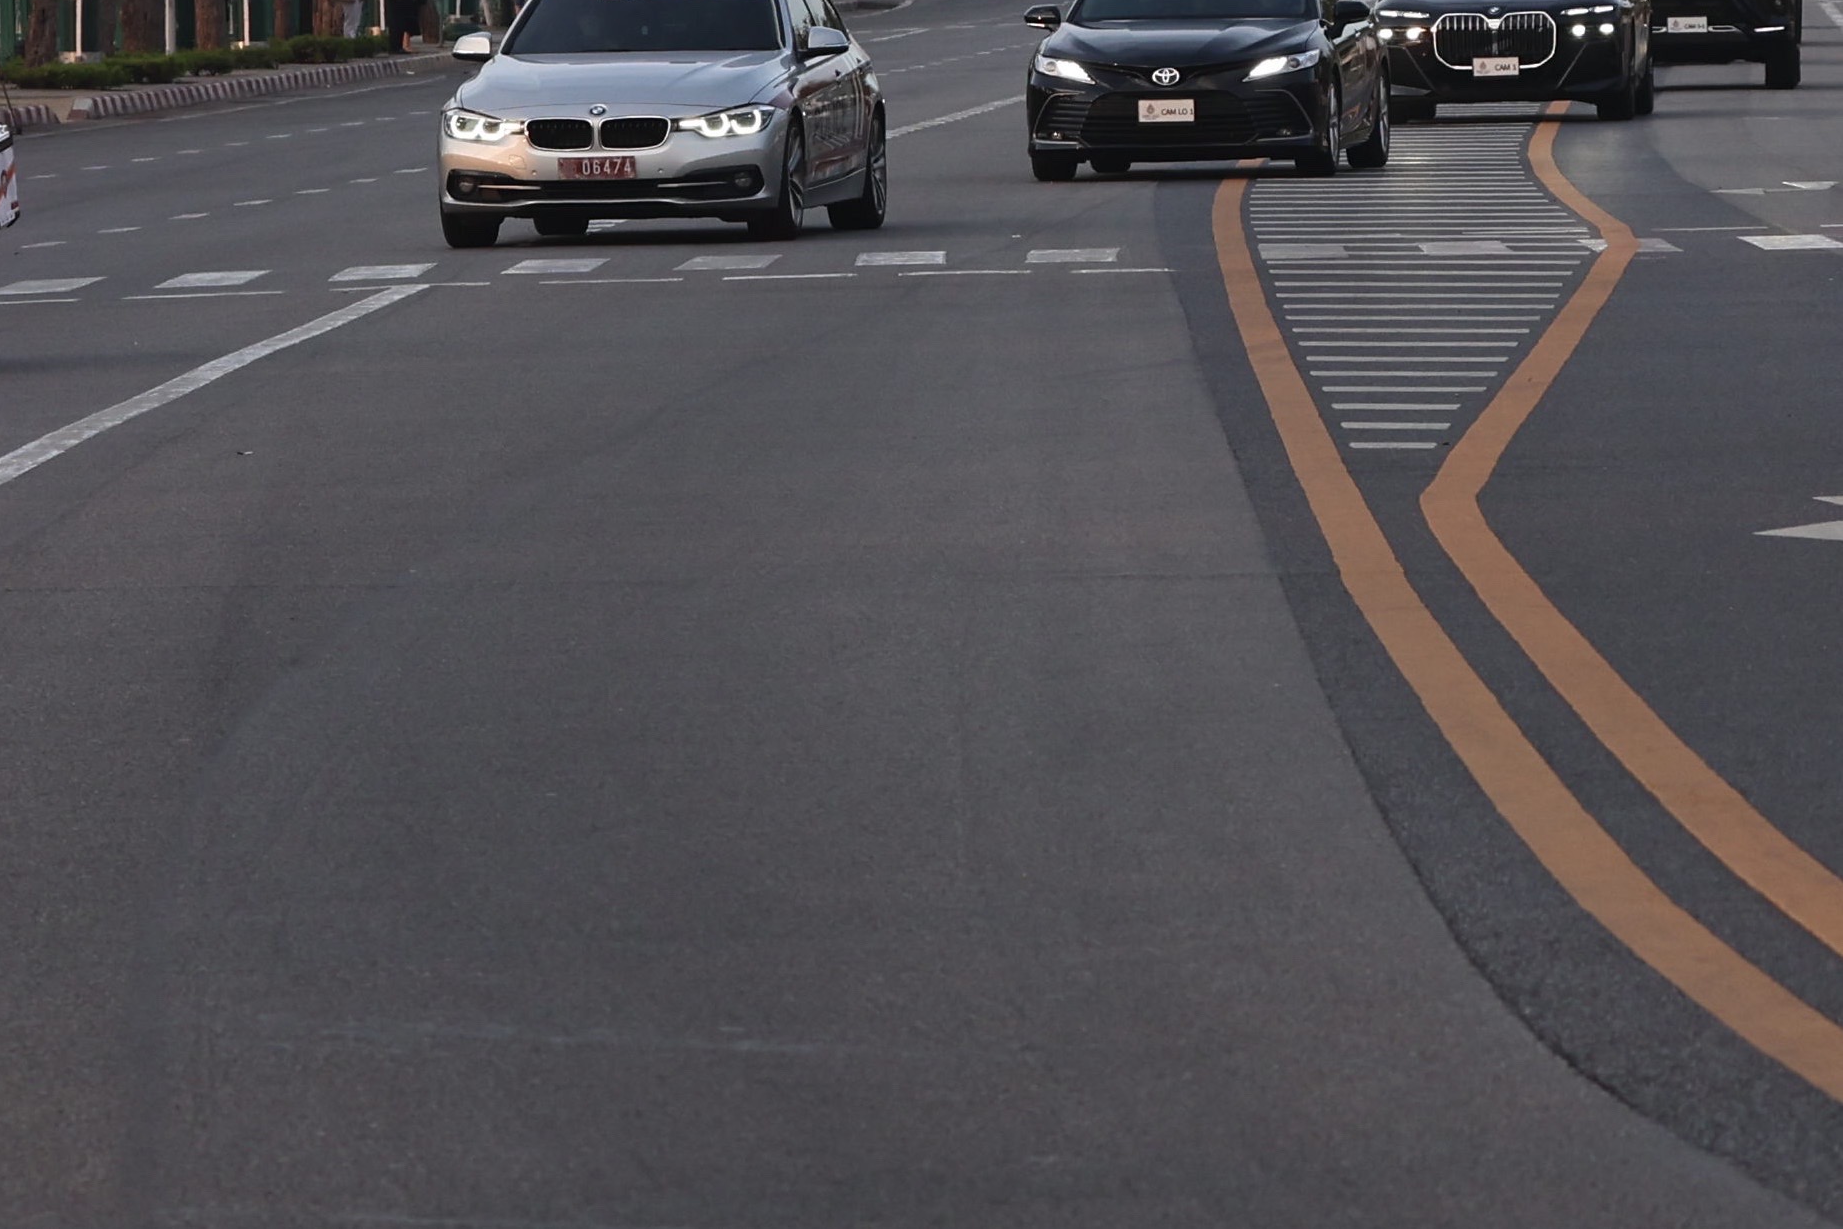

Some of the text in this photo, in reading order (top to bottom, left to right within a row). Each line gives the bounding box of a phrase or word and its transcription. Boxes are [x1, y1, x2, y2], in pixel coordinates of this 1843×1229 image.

[1494, 63, 1511, 72] CAM
[1160, 107, 1177, 116] CAM
[582, 157, 632, 176] 06474
